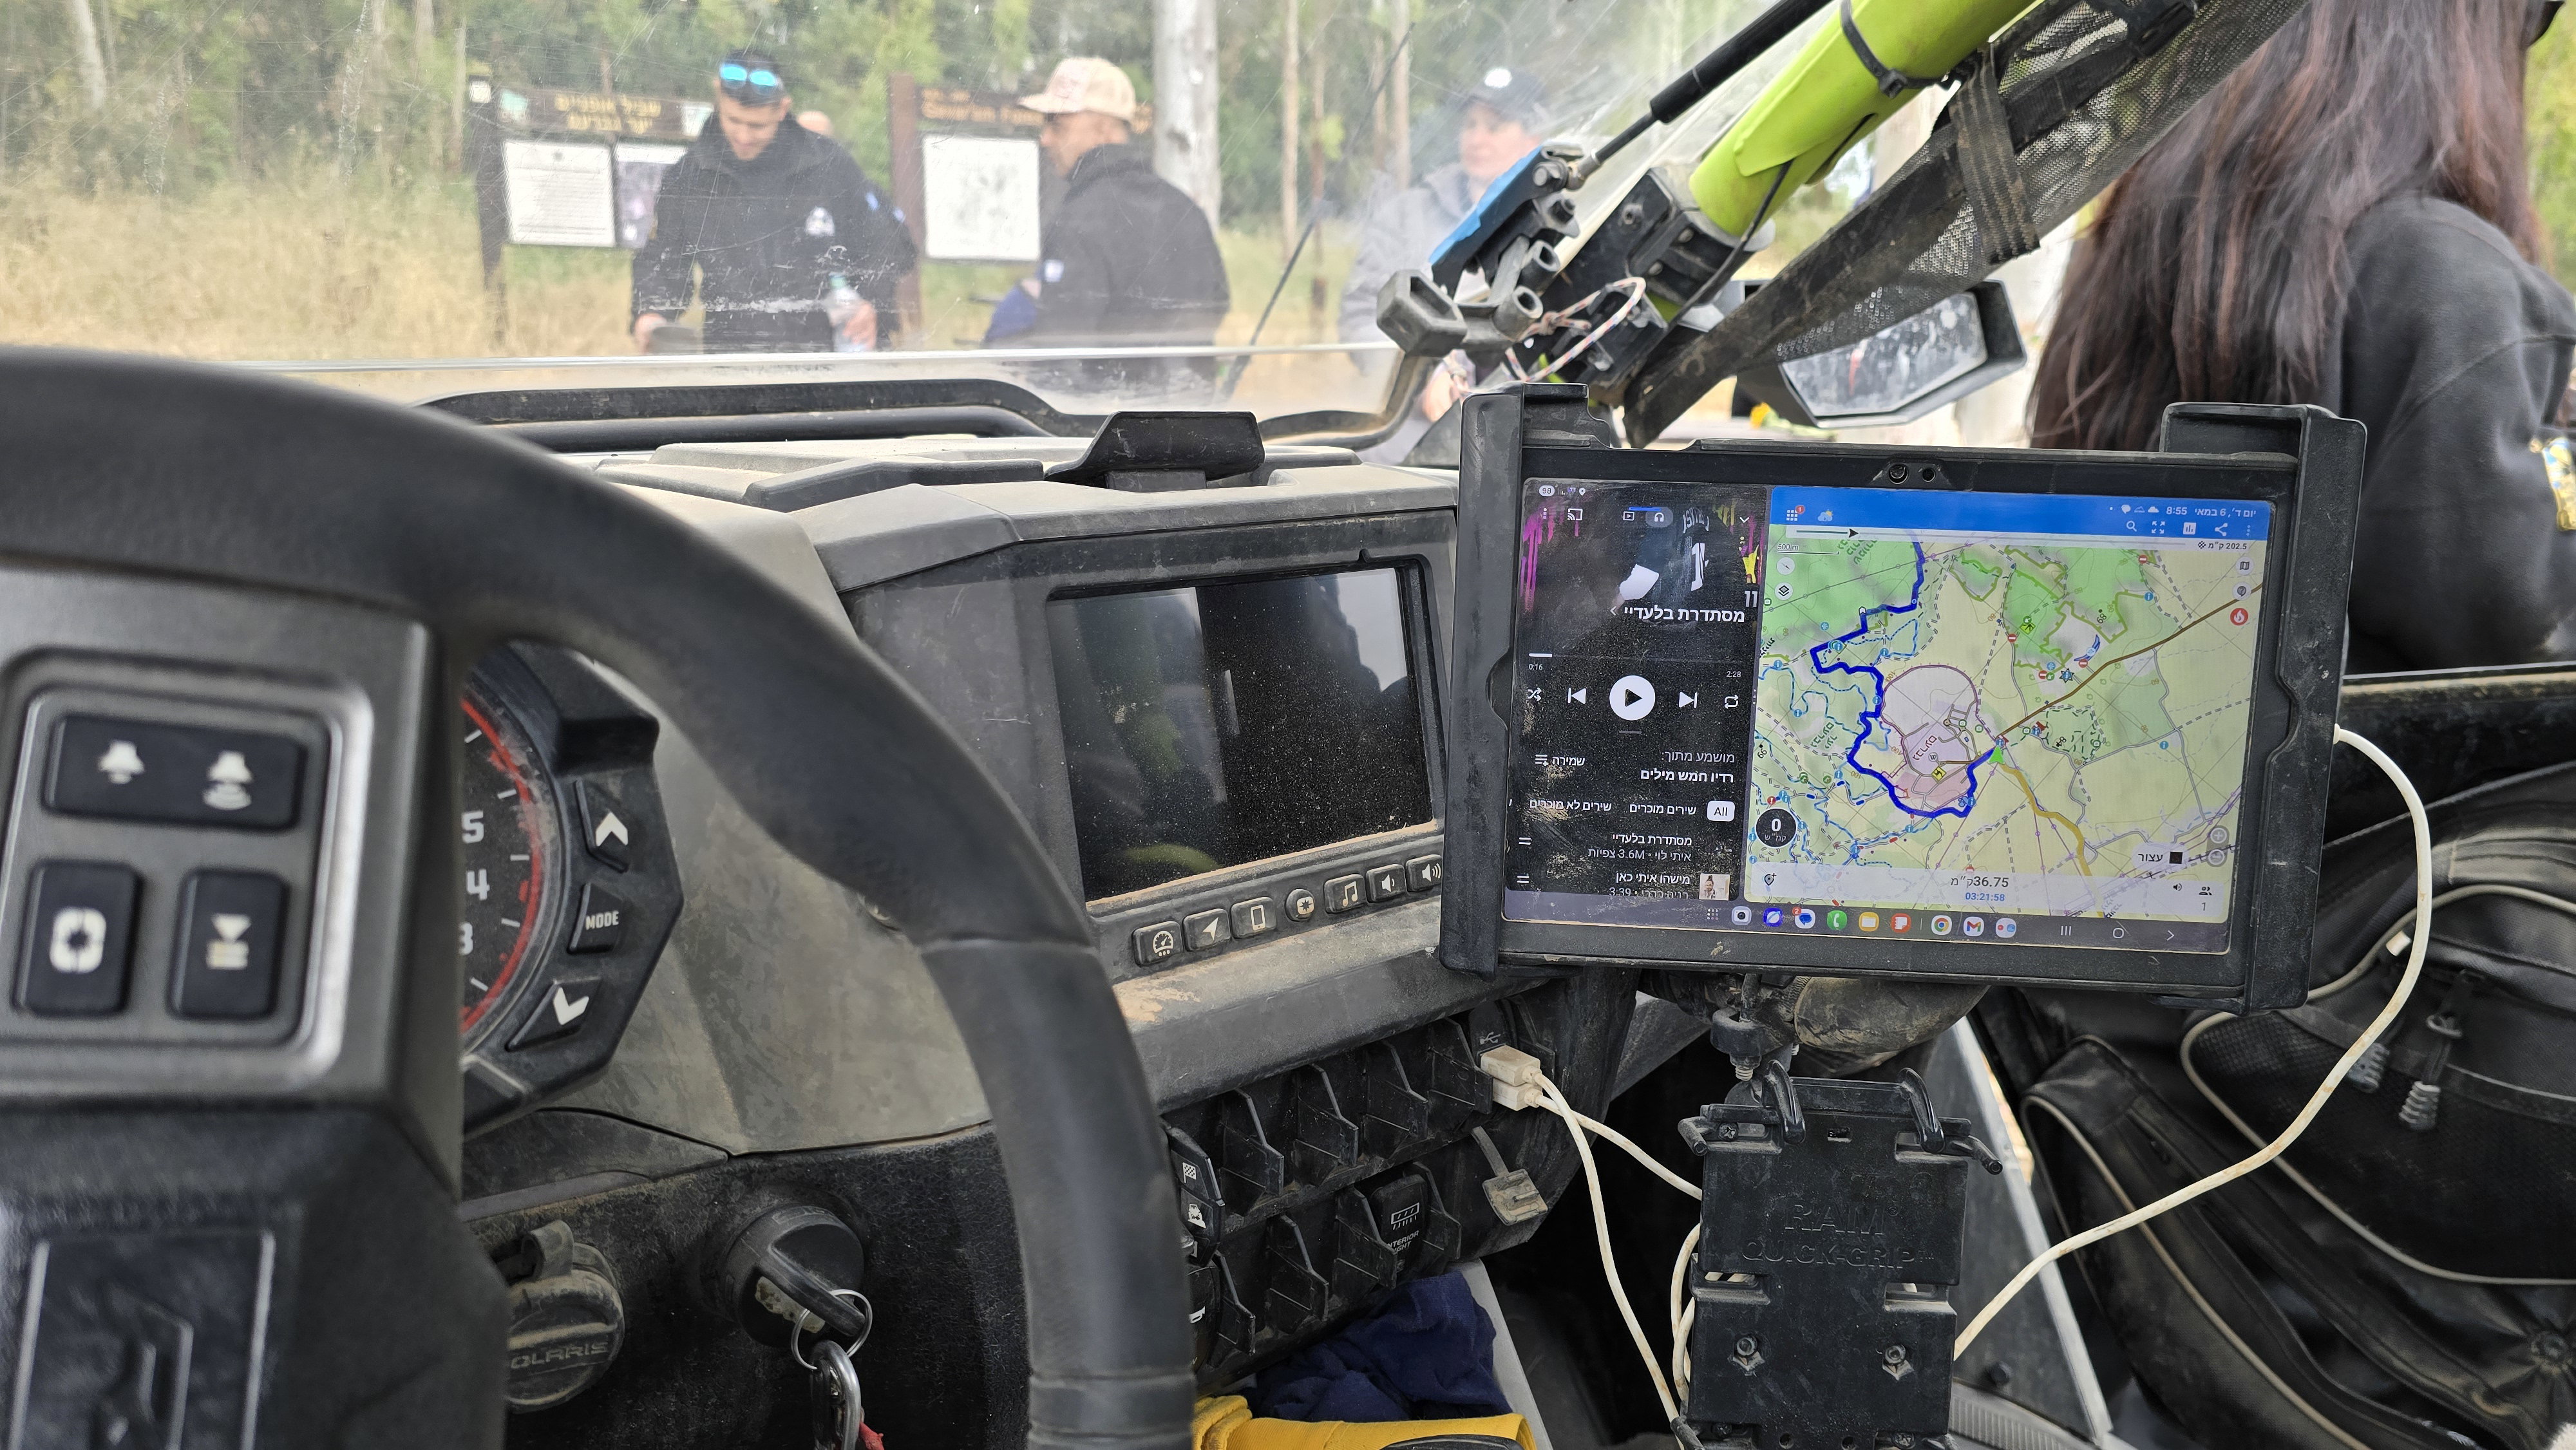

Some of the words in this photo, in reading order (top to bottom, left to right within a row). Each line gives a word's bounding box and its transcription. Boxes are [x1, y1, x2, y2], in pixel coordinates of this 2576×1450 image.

[2166, 506, 2188, 515] 8:55
[2195, 508, 2217, 516] במאי
[1624, 605, 1674, 620] בלעדיי
[1678, 608, 1745, 623] מסתדרת
[1552, 757, 1586, 766] שמירה
[1696, 752, 1735, 763] מושמע
[1640, 768, 1674, 780] מילים
[1678, 771, 1707, 782] חמש
[1710, 773, 1734, 783] רדיו
[1566, 799, 1580, 810] לא
[1582, 801, 1612, 811] שירים
[1629, 804, 1664, 814] מוכרים
[1667, 805, 1696, 815] שירים
[1714, 807, 1728, 816] All
[461, 811, 484, 843] 5
[1771, 818, 1781, 832] 0
[1647, 835, 1692, 846] מסתדרת
[1587, 848, 1616, 858] צפיות
[1618, 849, 1645, 860] 3.6M
[1654, 849, 1667, 860] לוי
[1670, 851, 1692, 862] איתי
[2137, 853, 2163, 862] עצור
[1616, 872, 1633, 883] כאן
[1636, 873, 1657, 883] איתי
[1660, 874, 1690, 885] מישהו
[466, 869, 490, 900] 4
[1965, 892, 2005, 901] 03:21:58
[585, 910, 620, 930] MODE
[1387, 1230, 1419, 1248] NTERIOR
[1394, 1240, 1412, 1253] IGHT
[511, 1341, 609, 1370] OLARIS
